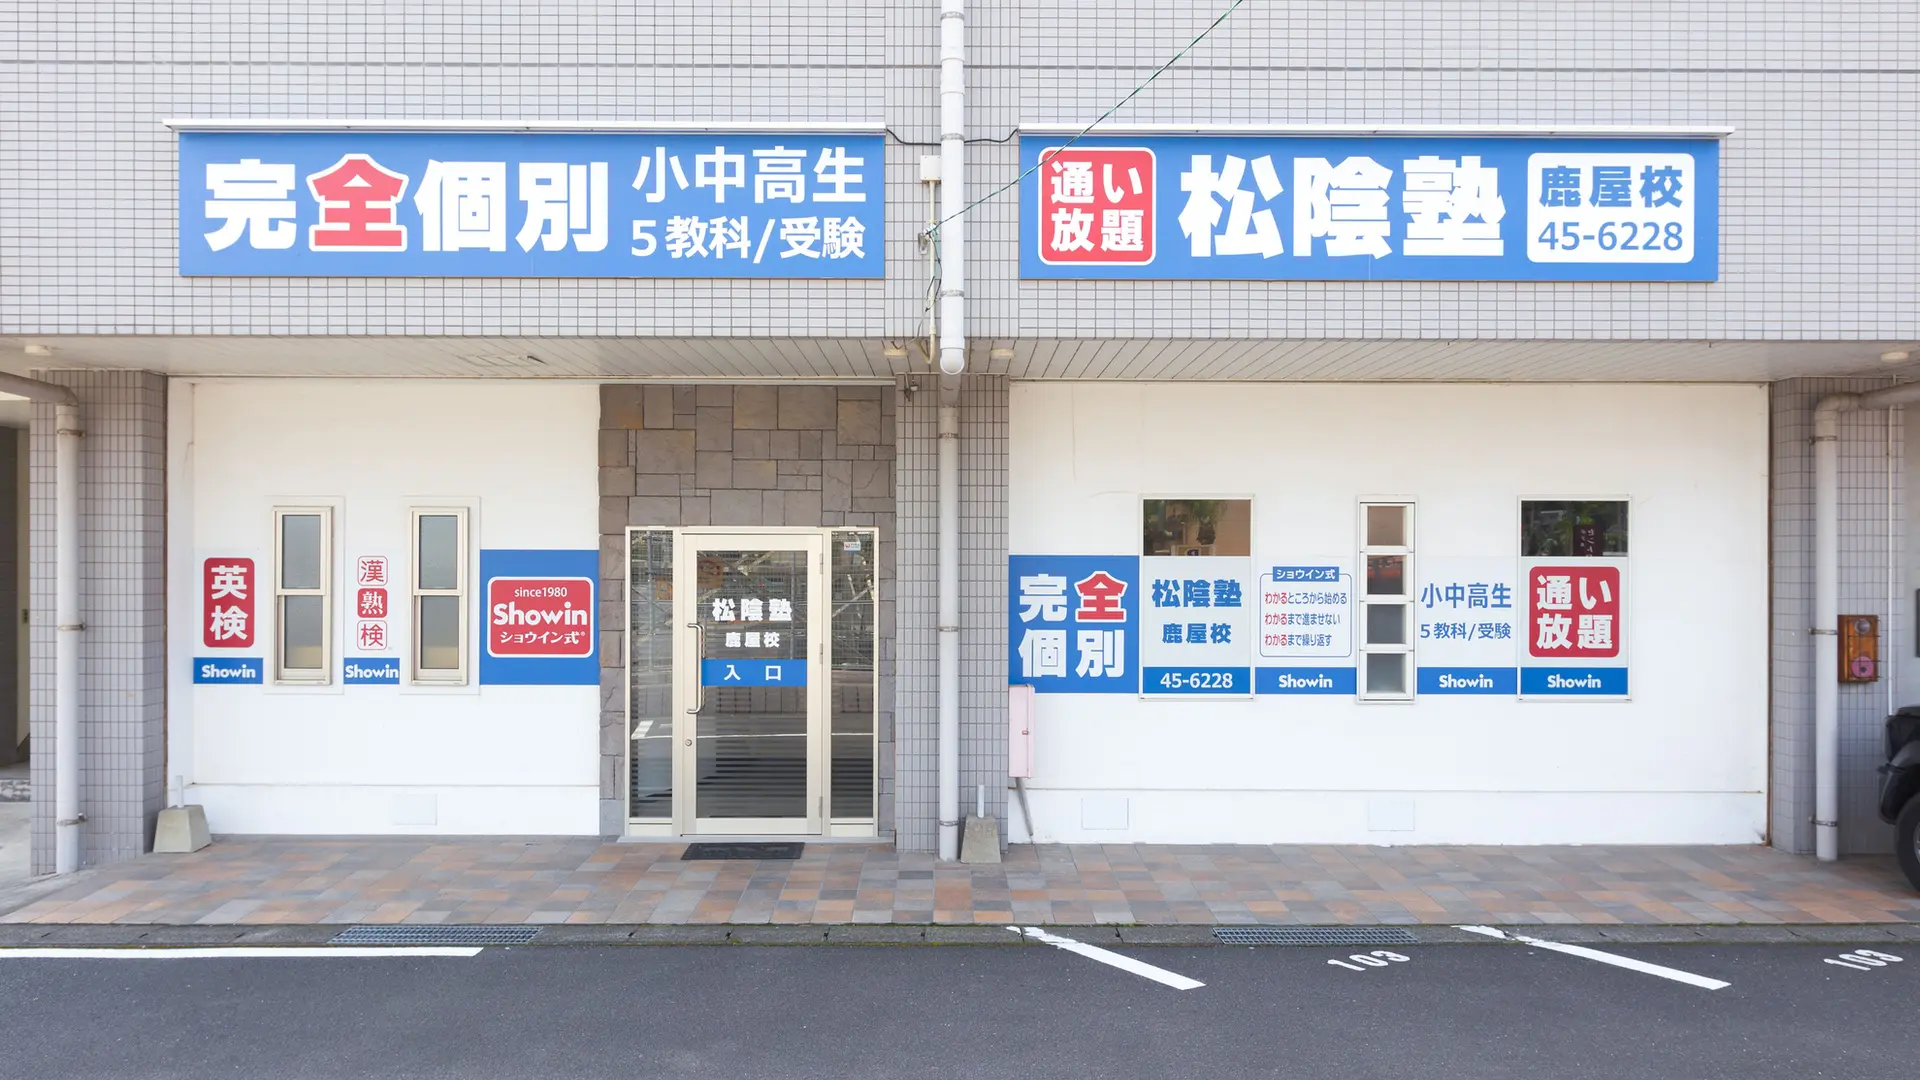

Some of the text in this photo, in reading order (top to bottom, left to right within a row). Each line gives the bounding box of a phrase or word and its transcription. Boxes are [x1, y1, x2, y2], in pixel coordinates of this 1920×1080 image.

[632, 146, 866, 203] 小中高生
[1051, 162, 1142, 203] 通い
[1540, 166, 1682, 207] 鹿屋校
[204, 154, 608, 252] 完全個別
[1178, 155, 1506, 259] 松陰塾
[632, 216, 865, 263] 5教科/受験
[1051, 208, 1143, 251] 放題
[1539, 222, 1682, 250] 45-6228
[1277, 569, 1335, 579] ショウイン式
[210, 565, 248, 640] 英検
[360, 560, 384, 646] 漢熟検
[1020, 571, 1128, 622] 完全
[1152, 580, 1242, 607] 松陰塾
[1265, 593, 1347, 604] わかるところから始める
[1421, 583, 1511, 608] 小中高生
[1537, 575, 1611, 609] 通い
[494, 602, 587, 625] Showin
[712, 598, 792, 621] 松陰塾
[1265, 614, 1340, 625] わかるまで進ませない
[1163, 623, 1231, 643] 鹿屋校
[1265, 634, 1331, 646] わかるまで繰り返す
[1537, 614, 1612, 649] 放題
[1018, 629, 1124, 677] 個別
[202, 663, 256, 679] Showin
[345, 664, 399, 678] Showin
[1161, 673, 1232, 688] 45-6228
[1279, 674, 1332, 687] Showin
[1439, 674, 1493, 688] Showin
[1548, 674, 1601, 688] Showin
[1328, 951, 1410, 971] 103
[1824, 950, 1903, 970] 103
